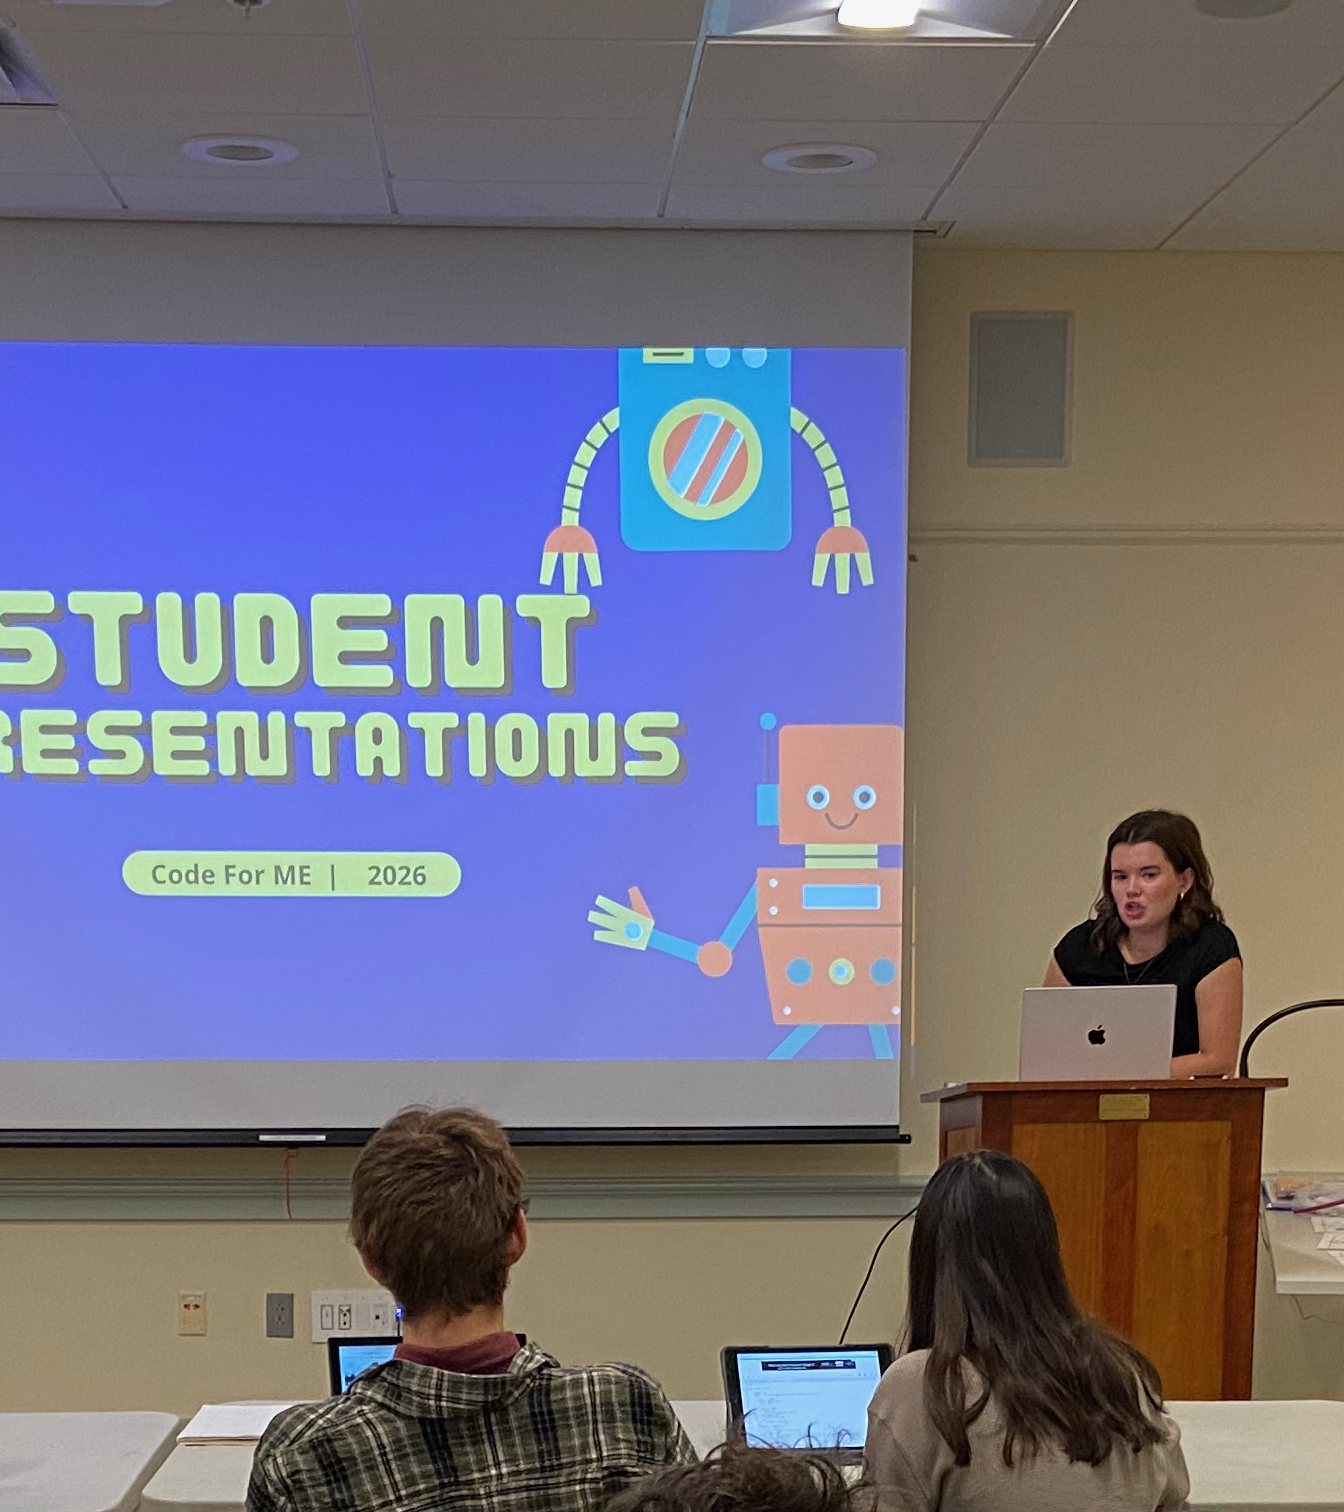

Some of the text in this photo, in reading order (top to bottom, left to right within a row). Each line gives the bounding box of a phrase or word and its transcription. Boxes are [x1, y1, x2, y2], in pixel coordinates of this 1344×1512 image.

[151, 864, 215, 886] Code
[225, 865, 265, 886] For
[274, 865, 312, 886] ME
[367, 865, 427, 887] 2026
